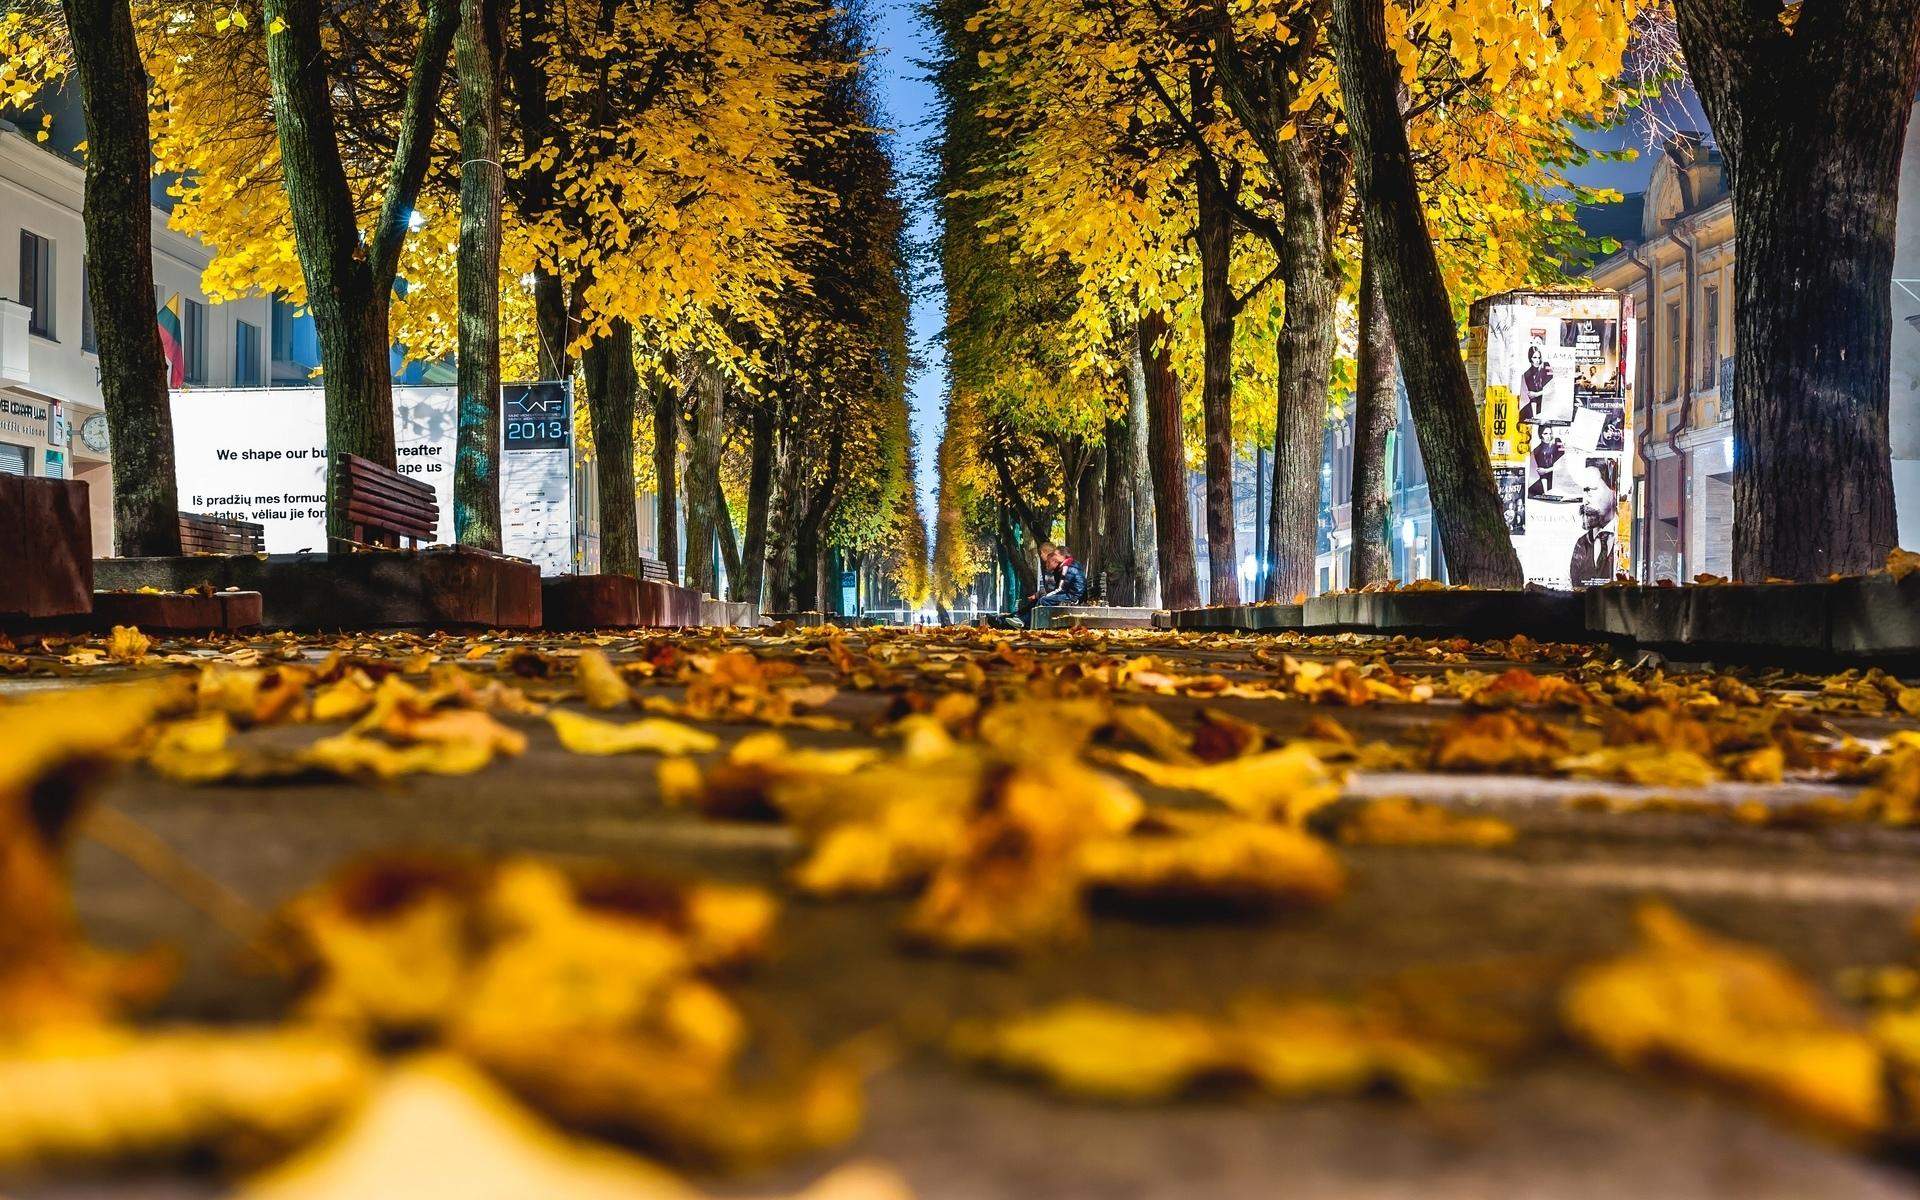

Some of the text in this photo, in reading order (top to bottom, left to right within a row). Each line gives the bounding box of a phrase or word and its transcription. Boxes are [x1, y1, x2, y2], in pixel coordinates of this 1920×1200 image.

[508, 421, 562, 439] 2013
[216, 444, 442, 462] We shape our bu reafter
[397, 463, 442, 475] ape us
[192, 493, 327, 507] Iš pradžių mes formuo
[207, 507, 326, 521] tatus, vėliau jie for
